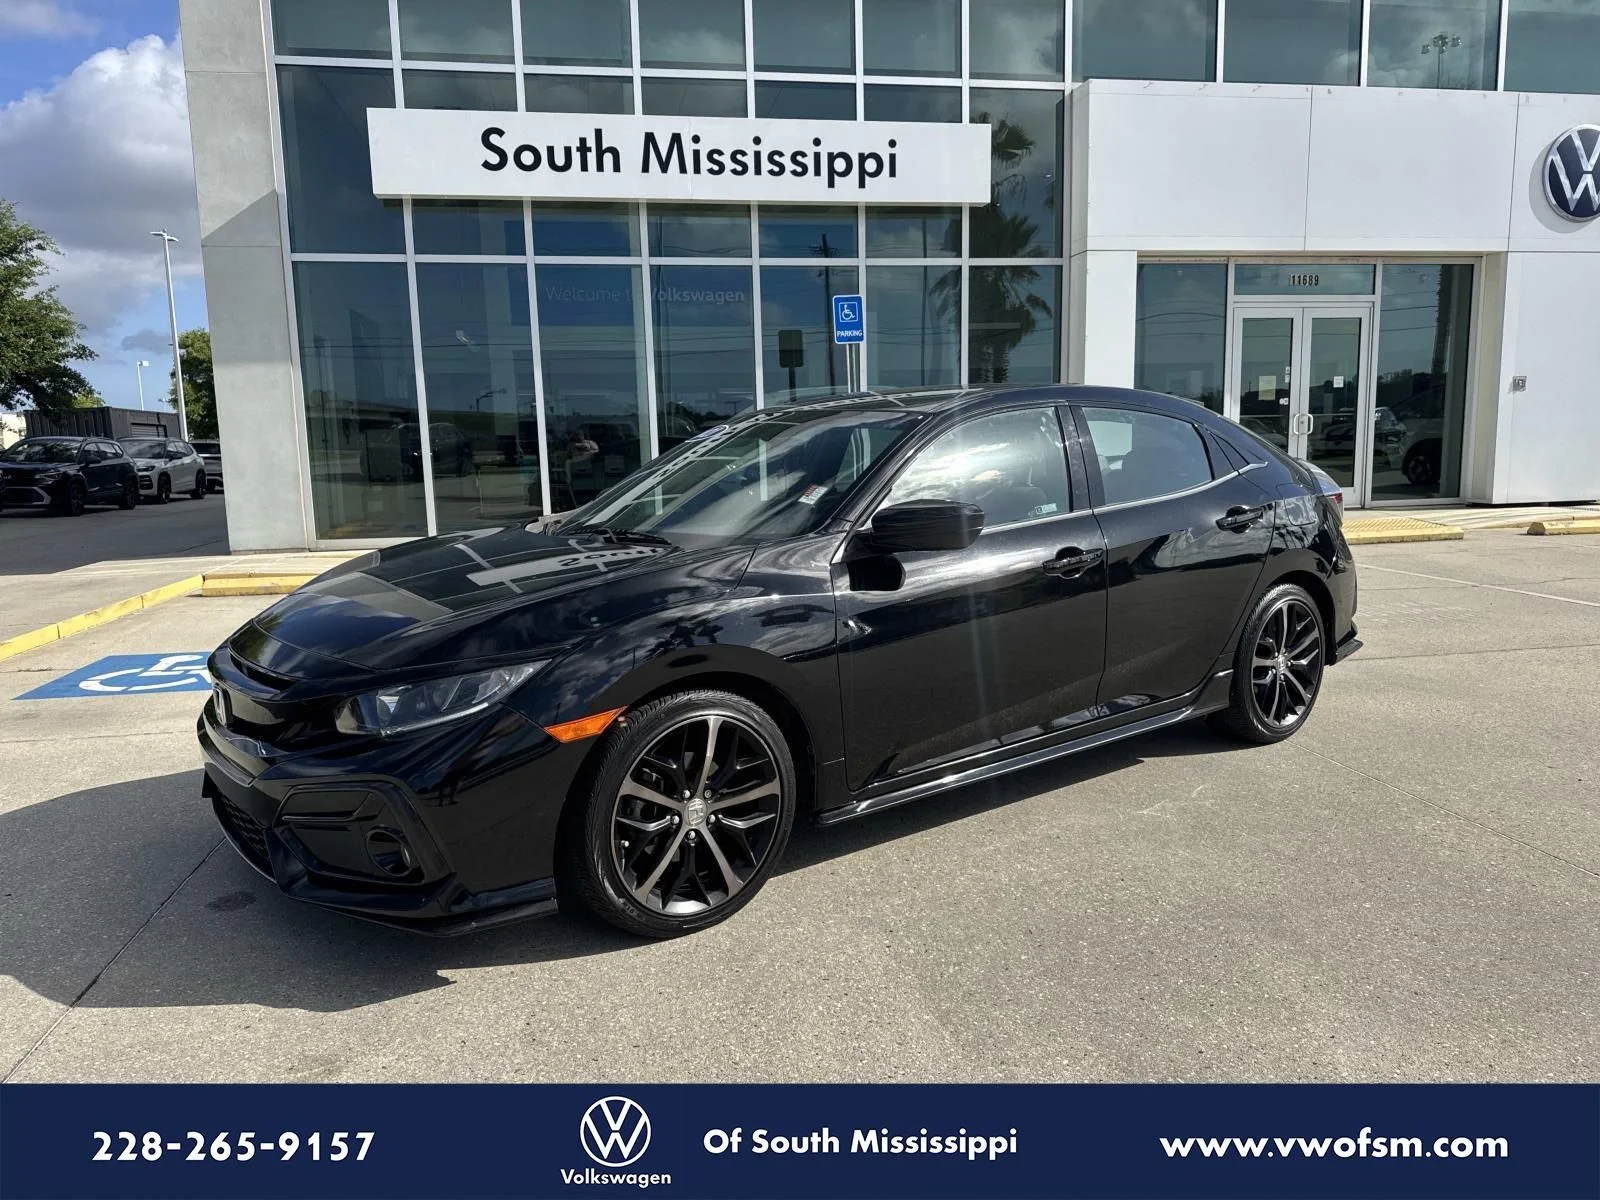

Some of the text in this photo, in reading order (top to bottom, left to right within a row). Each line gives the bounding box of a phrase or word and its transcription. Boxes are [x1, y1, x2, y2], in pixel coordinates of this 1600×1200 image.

[480, 126, 898, 189] South Mississippi
[1291, 274, 1319, 286] 11689
[545, 287, 620, 301] Welcome
